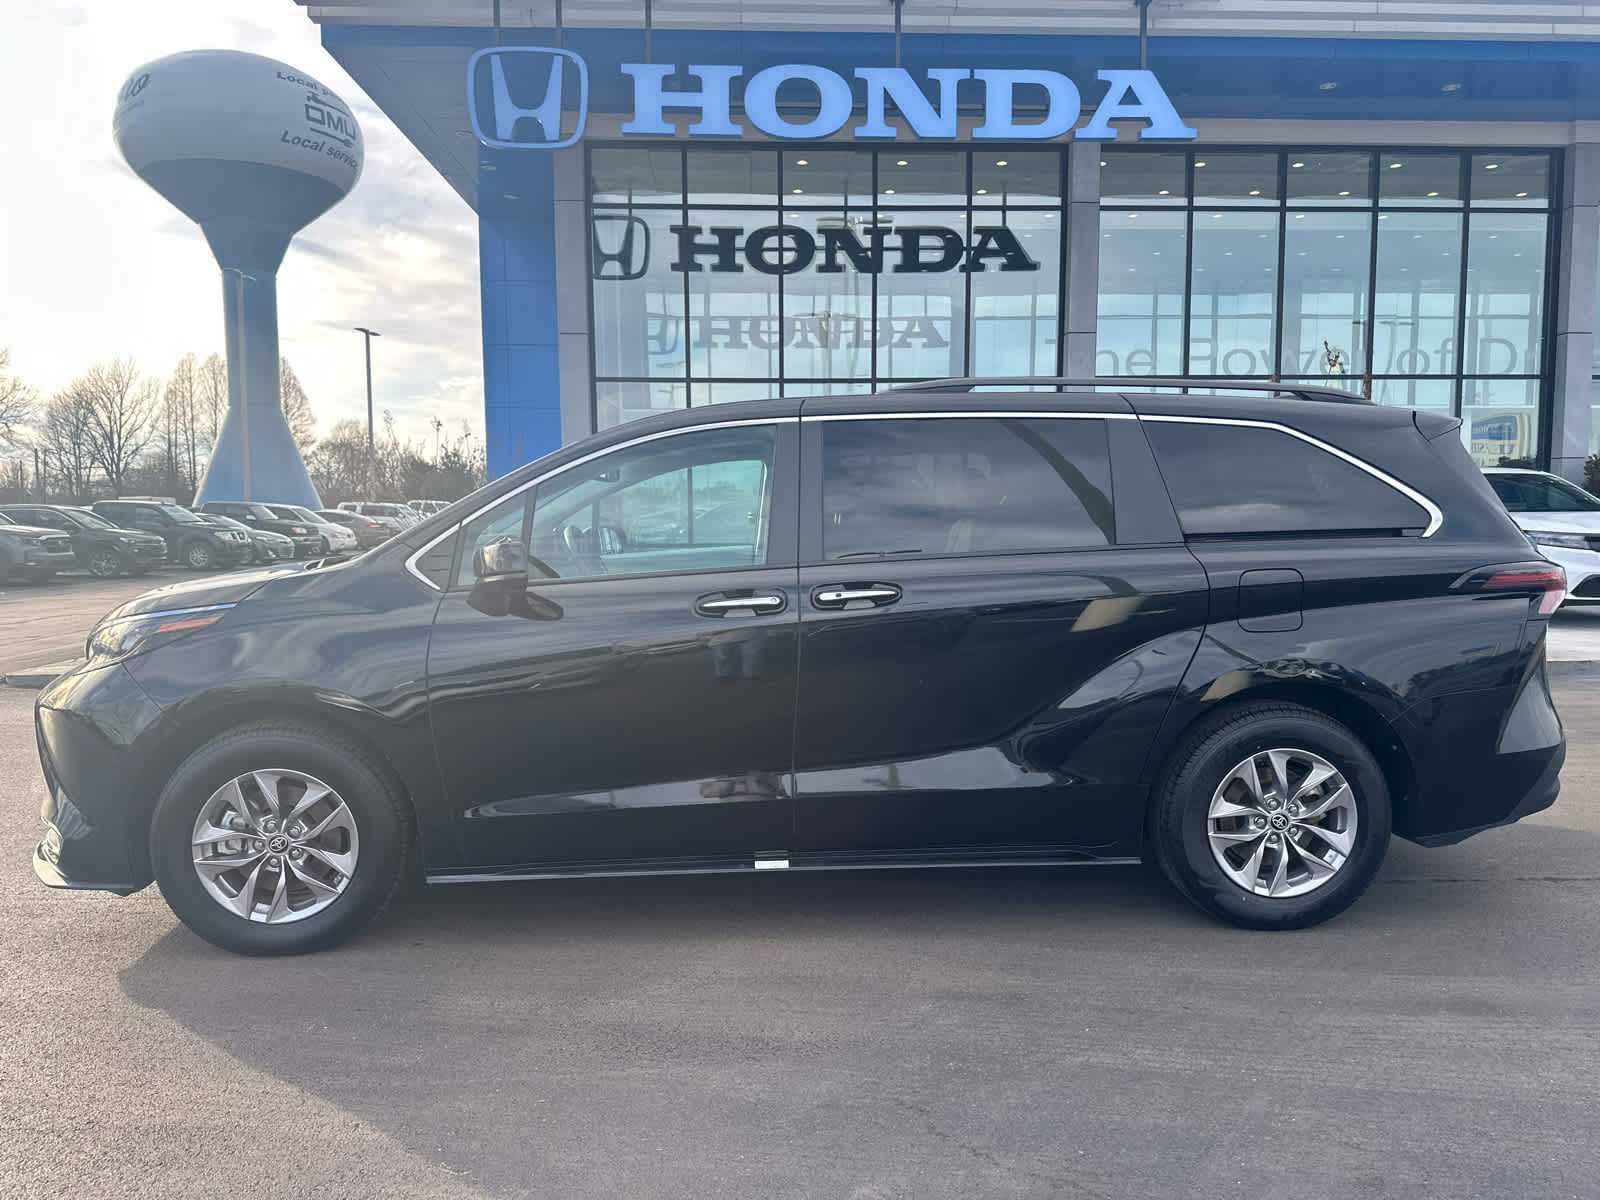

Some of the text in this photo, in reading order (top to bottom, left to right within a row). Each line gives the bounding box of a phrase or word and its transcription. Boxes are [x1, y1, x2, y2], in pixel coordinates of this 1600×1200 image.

[276, 71, 318, 90] Local
[621, 63, 1197, 141] HONDA
[281, 130, 325, 154] Local
[669, 224, 1040, 275] HONDA
[1190, 337, 1371, 376] Powe
